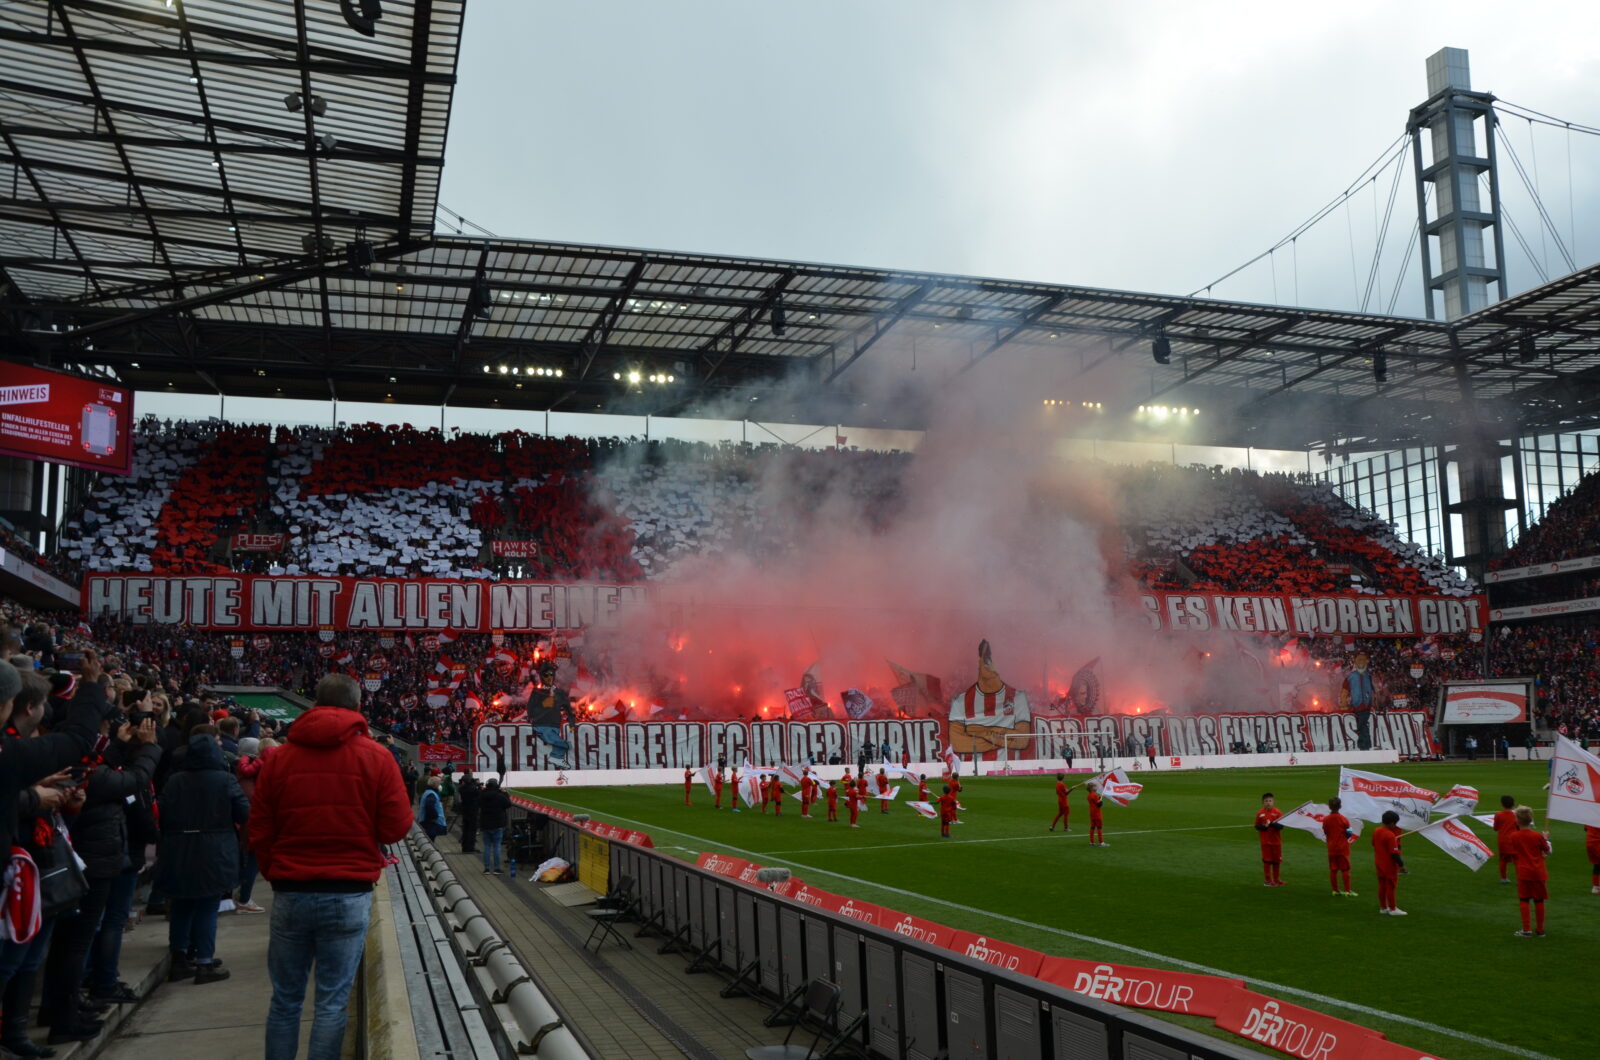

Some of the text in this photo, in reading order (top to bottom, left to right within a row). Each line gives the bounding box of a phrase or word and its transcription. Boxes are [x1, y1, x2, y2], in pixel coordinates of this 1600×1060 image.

[0, 387, 46, 401] HINWEIS
[1, 412, 70, 431] UNFALLHILFESTELLEN
[492, 541, 537, 554] HAWKS
[89, 577, 242, 627] HEUTE
[251, 579, 342, 628] MIT
[348, 582, 481, 630] ALLEN
[1166, 595, 1211, 634] ES
[1215, 596, 1289, 634] KEIN
[1291, 597, 1415, 635] MORGEN
[1419, 598, 1481, 636] GIBT
[625, 722, 705, 770] BEIM
[709, 721, 749, 767] FC
[751, 720, 787, 767] IN
[1167, 714, 1219, 756] DAS
[1073, 965, 1194, 1012] DERTOUR
[1239, 1000, 1337, 1060] DERTOUR
